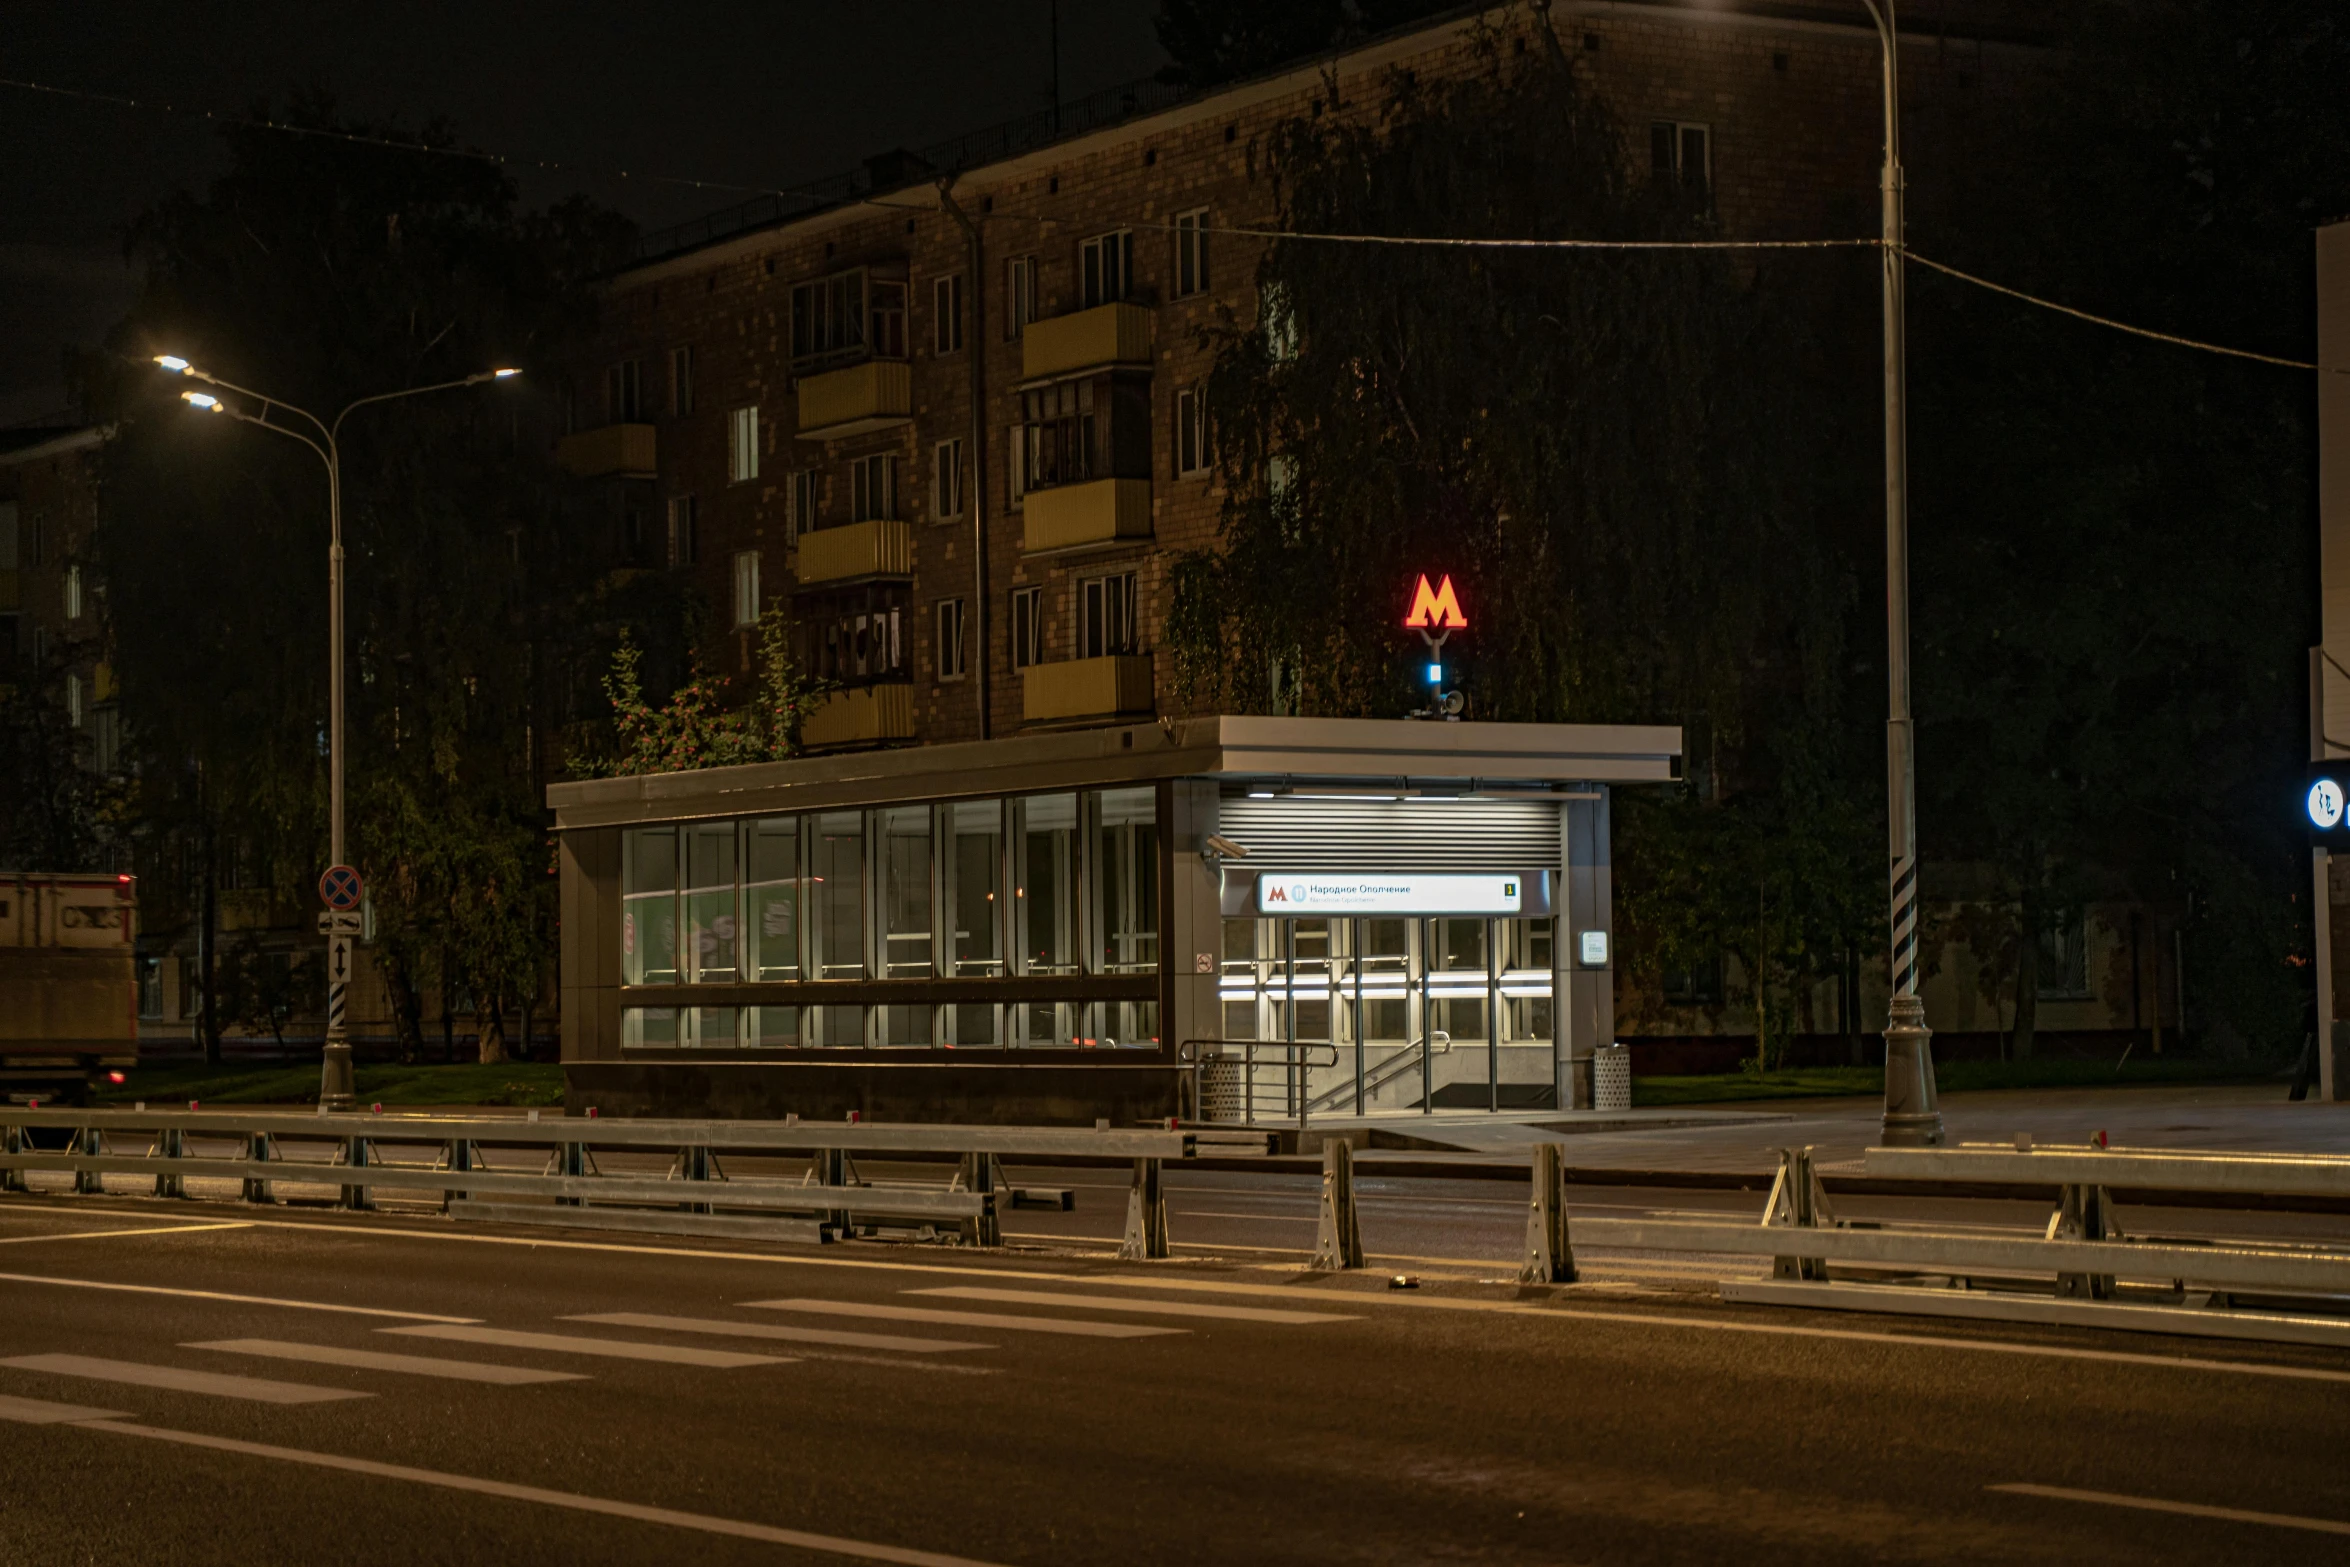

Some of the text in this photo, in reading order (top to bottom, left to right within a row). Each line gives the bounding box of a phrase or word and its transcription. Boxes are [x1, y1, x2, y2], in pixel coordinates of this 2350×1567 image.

[1405, 573, 1467, 627] М
[1310, 885, 1411, 895] Народное Ополчение
